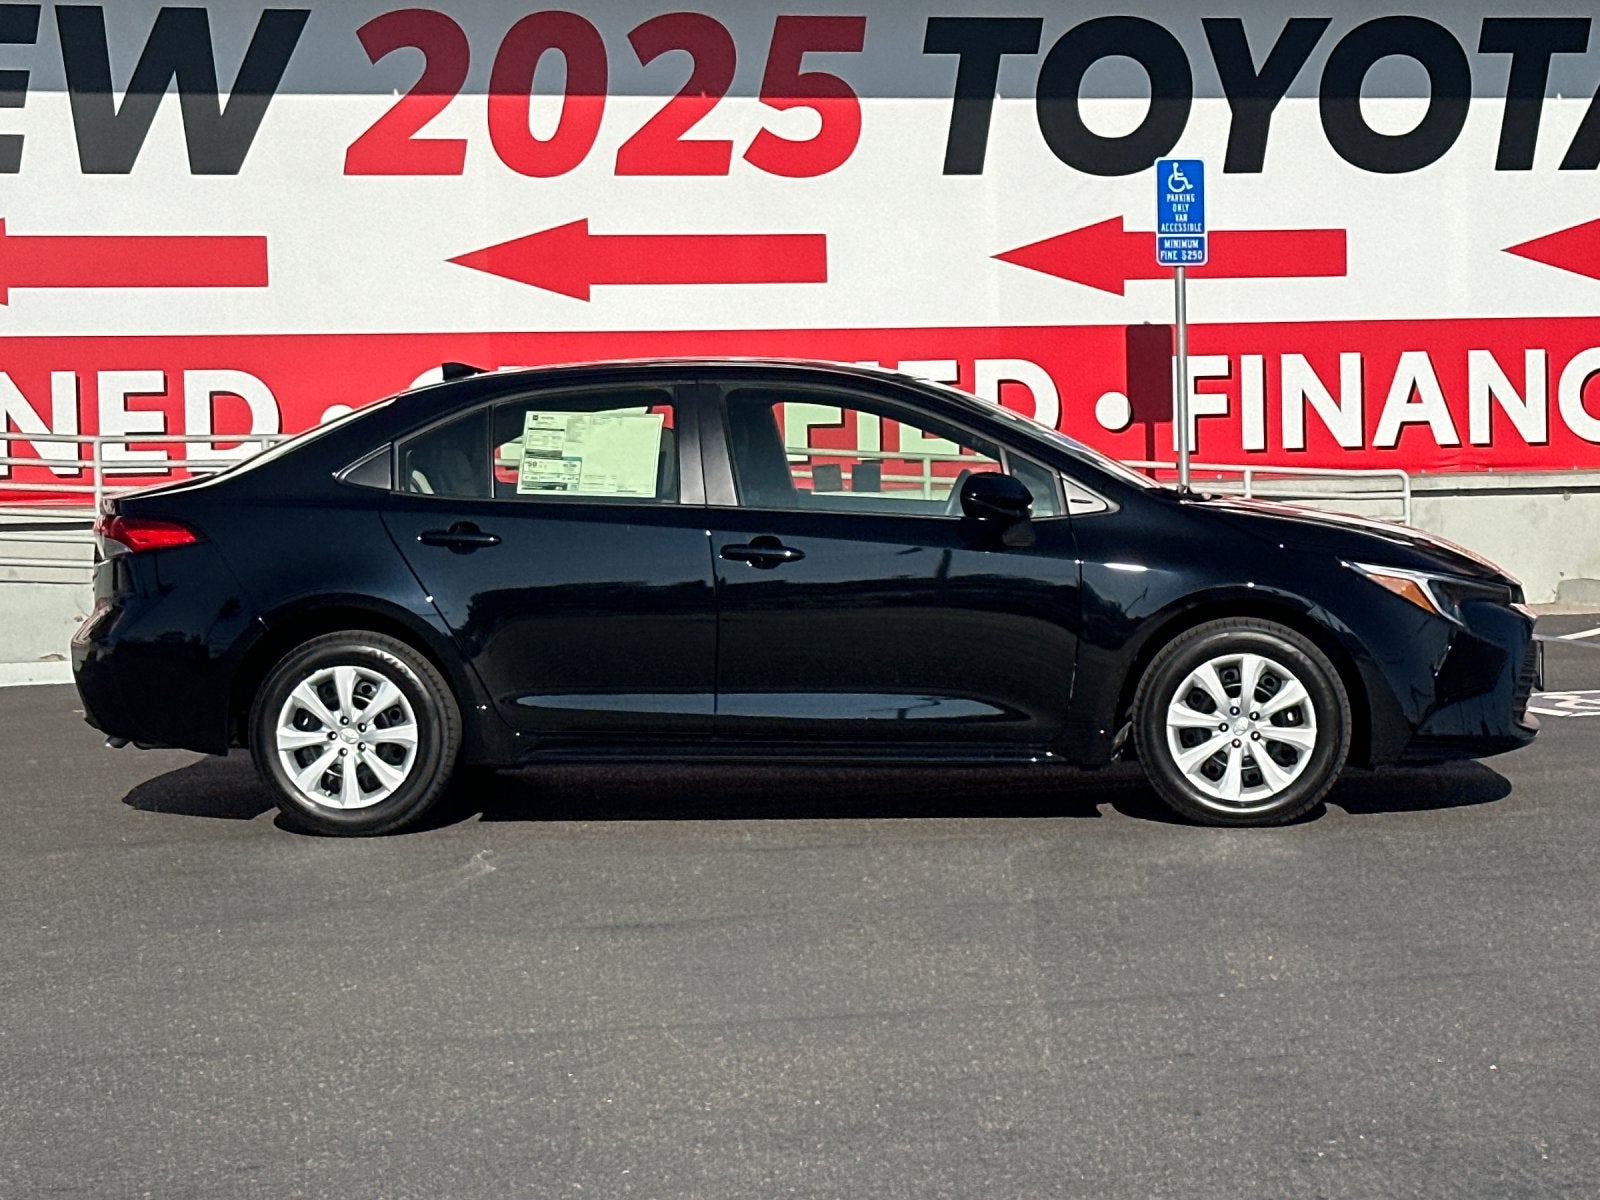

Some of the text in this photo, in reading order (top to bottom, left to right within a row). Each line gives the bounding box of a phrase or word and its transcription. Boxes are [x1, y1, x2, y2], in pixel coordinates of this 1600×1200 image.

[344, 9, 865, 179] 2025
[1166, 193, 1195, 202] PARKING
[1172, 203, 1189, 212] ONLY
[1175, 213, 1188, 222] VAN
[1161, 223, 1202, 232] ACCESSIBLE
[1164, 239, 1199, 249] MINIMUM
[1160, 250, 1203, 260] FINE $250
